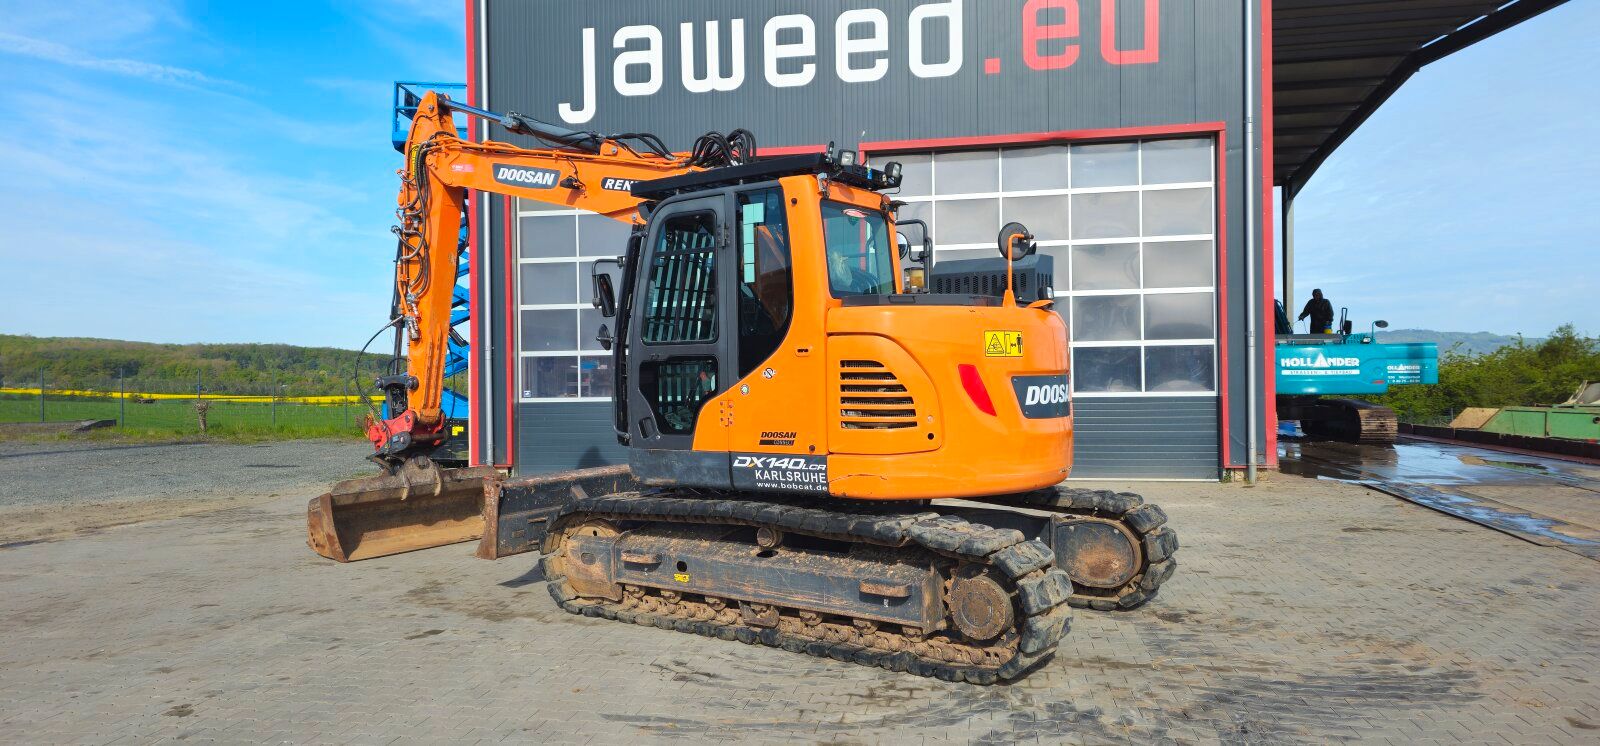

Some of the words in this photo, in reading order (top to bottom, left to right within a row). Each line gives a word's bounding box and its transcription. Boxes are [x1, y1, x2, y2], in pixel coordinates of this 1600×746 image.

[558, 0, 1160, 124] jaweed.eu
[497, 167, 555, 185] DOOSAN
[604, 178, 639, 191] REN
[1025, 384, 1070, 405] DOOSA
[755, 470, 827, 483] KARLSRUHE
[756, 482, 828, 491] www.bobcat.de
